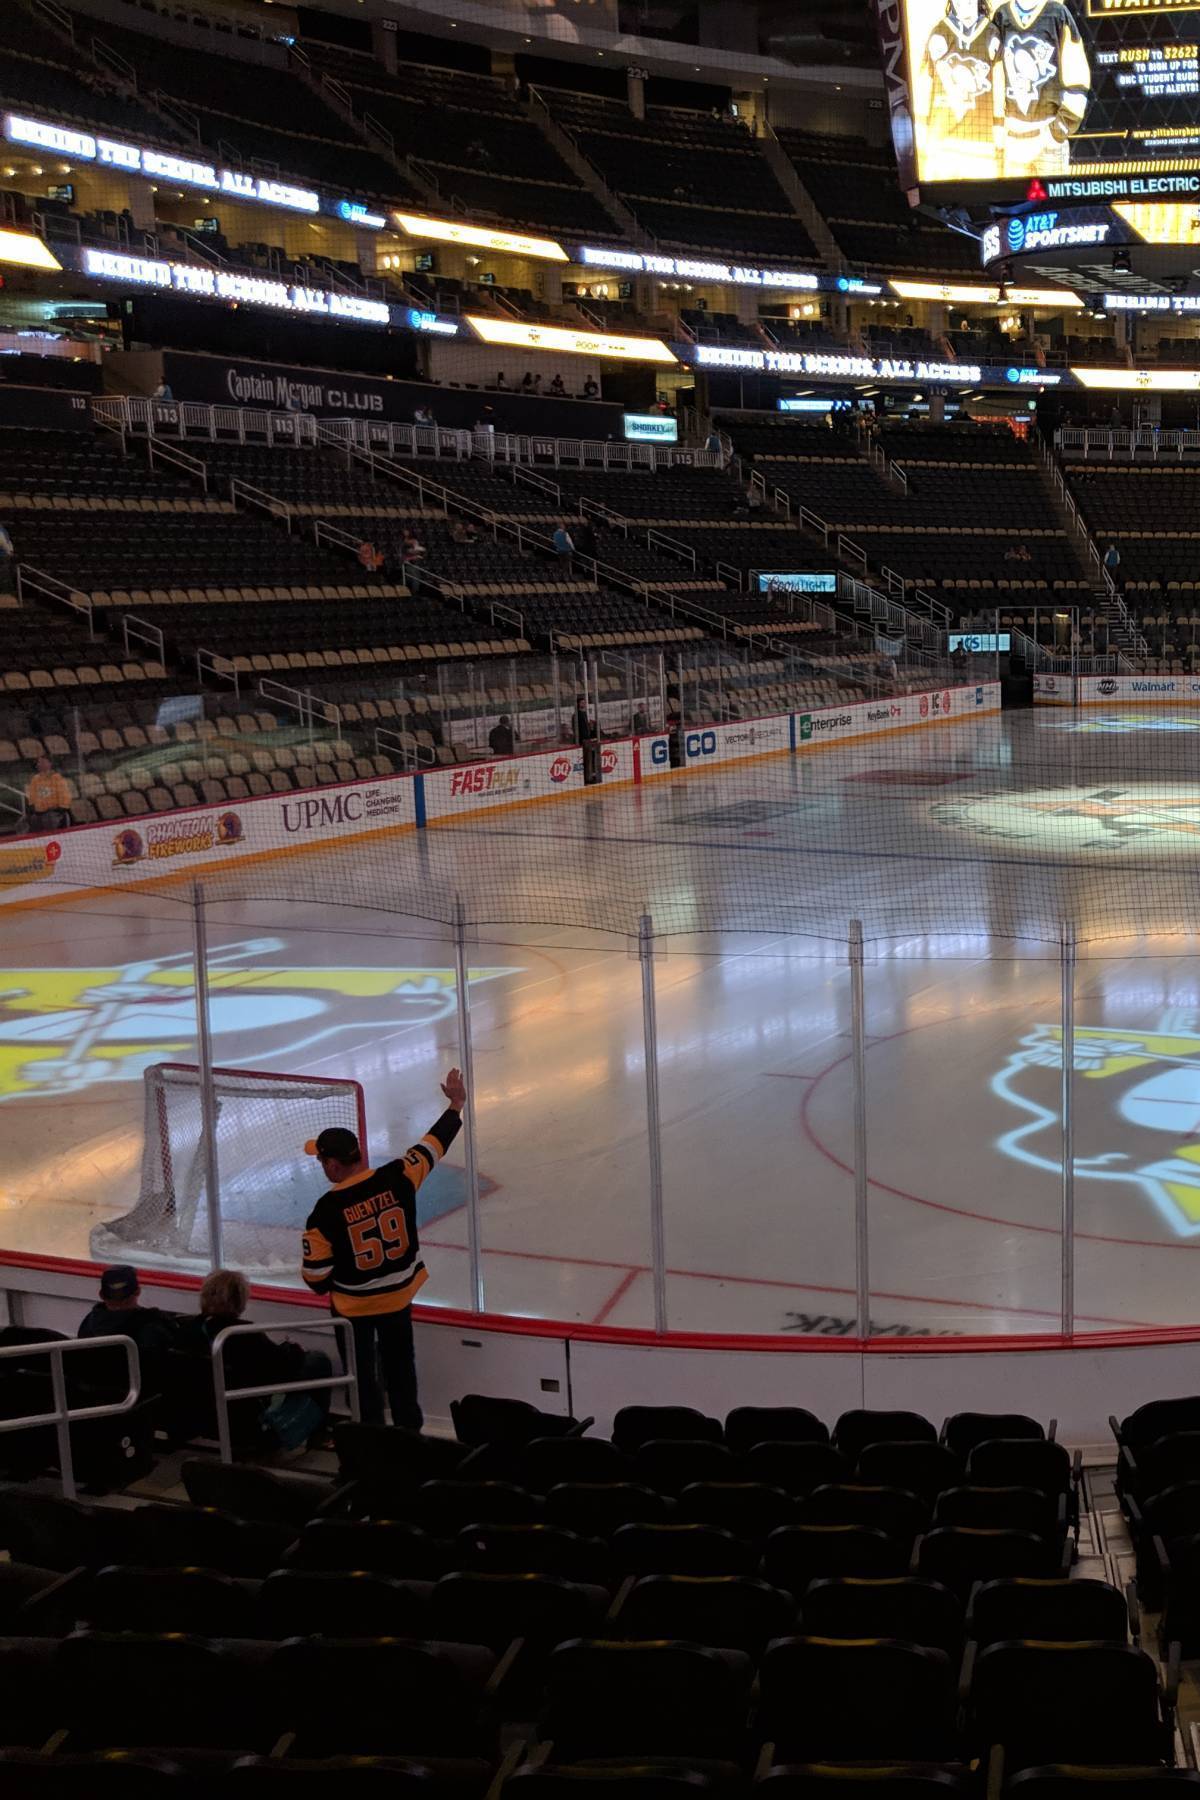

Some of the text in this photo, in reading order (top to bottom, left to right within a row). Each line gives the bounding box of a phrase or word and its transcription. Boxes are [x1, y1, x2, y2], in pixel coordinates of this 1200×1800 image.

[1098, 54, 1118, 63] TEXT
[1120, 50, 1150, 62] RUSH
[1151, 52, 1163, 60] TO
[627, 66, 649, 80] 224
[1136, 61, 1199, 72] TO SIGN UP FOR
[1139, 74, 1174, 83] STUDENT
[1176, 72, 1199, 81] RUSH
[1144, 83, 1199, 95] TEXT ALERTS!
[1048, 176, 1200, 198] MITSUBISHI ELECTRIC
[1025, 213, 1058, 231] AT&T
[1025, 224, 1110, 248] SPORTSNET
[879, 360, 914, 378] ALL
[916, 363, 981, 381] ACCESS
[228, 368, 384, 412] Captain Morgan CLUB
[930, 387, 948, 397] 116
[72, 397, 86, 409] 112
[156, 407, 178, 423] 113
[275, 419, 294, 434] 113
[372, 428, 388, 440] 114
[535, 443, 553, 456] 115
[675, 453, 693, 465] 115
[800, 580, 828, 592] LIGHT
[1131, 682, 1175, 692] Walmart
[867, 709, 890, 722] KeyBank
[801, 713, 852, 735] enterprise
[725, 734, 749, 744] VECTOR
[600, 754, 617, 769] DQ
[553, 762, 569, 777] DQ
[451, 766, 496, 797] FAST
[365, 788, 402, 817] LIFE CHANGING MEDICINE
[281, 791, 363, 833] UPMC
[146, 815, 214, 842] PHANTOM
[148, 832, 214, 859] FIREWORKS
[343, 1190, 400, 1223] GUENTZEL
[347, 1205, 410, 1271] 59
